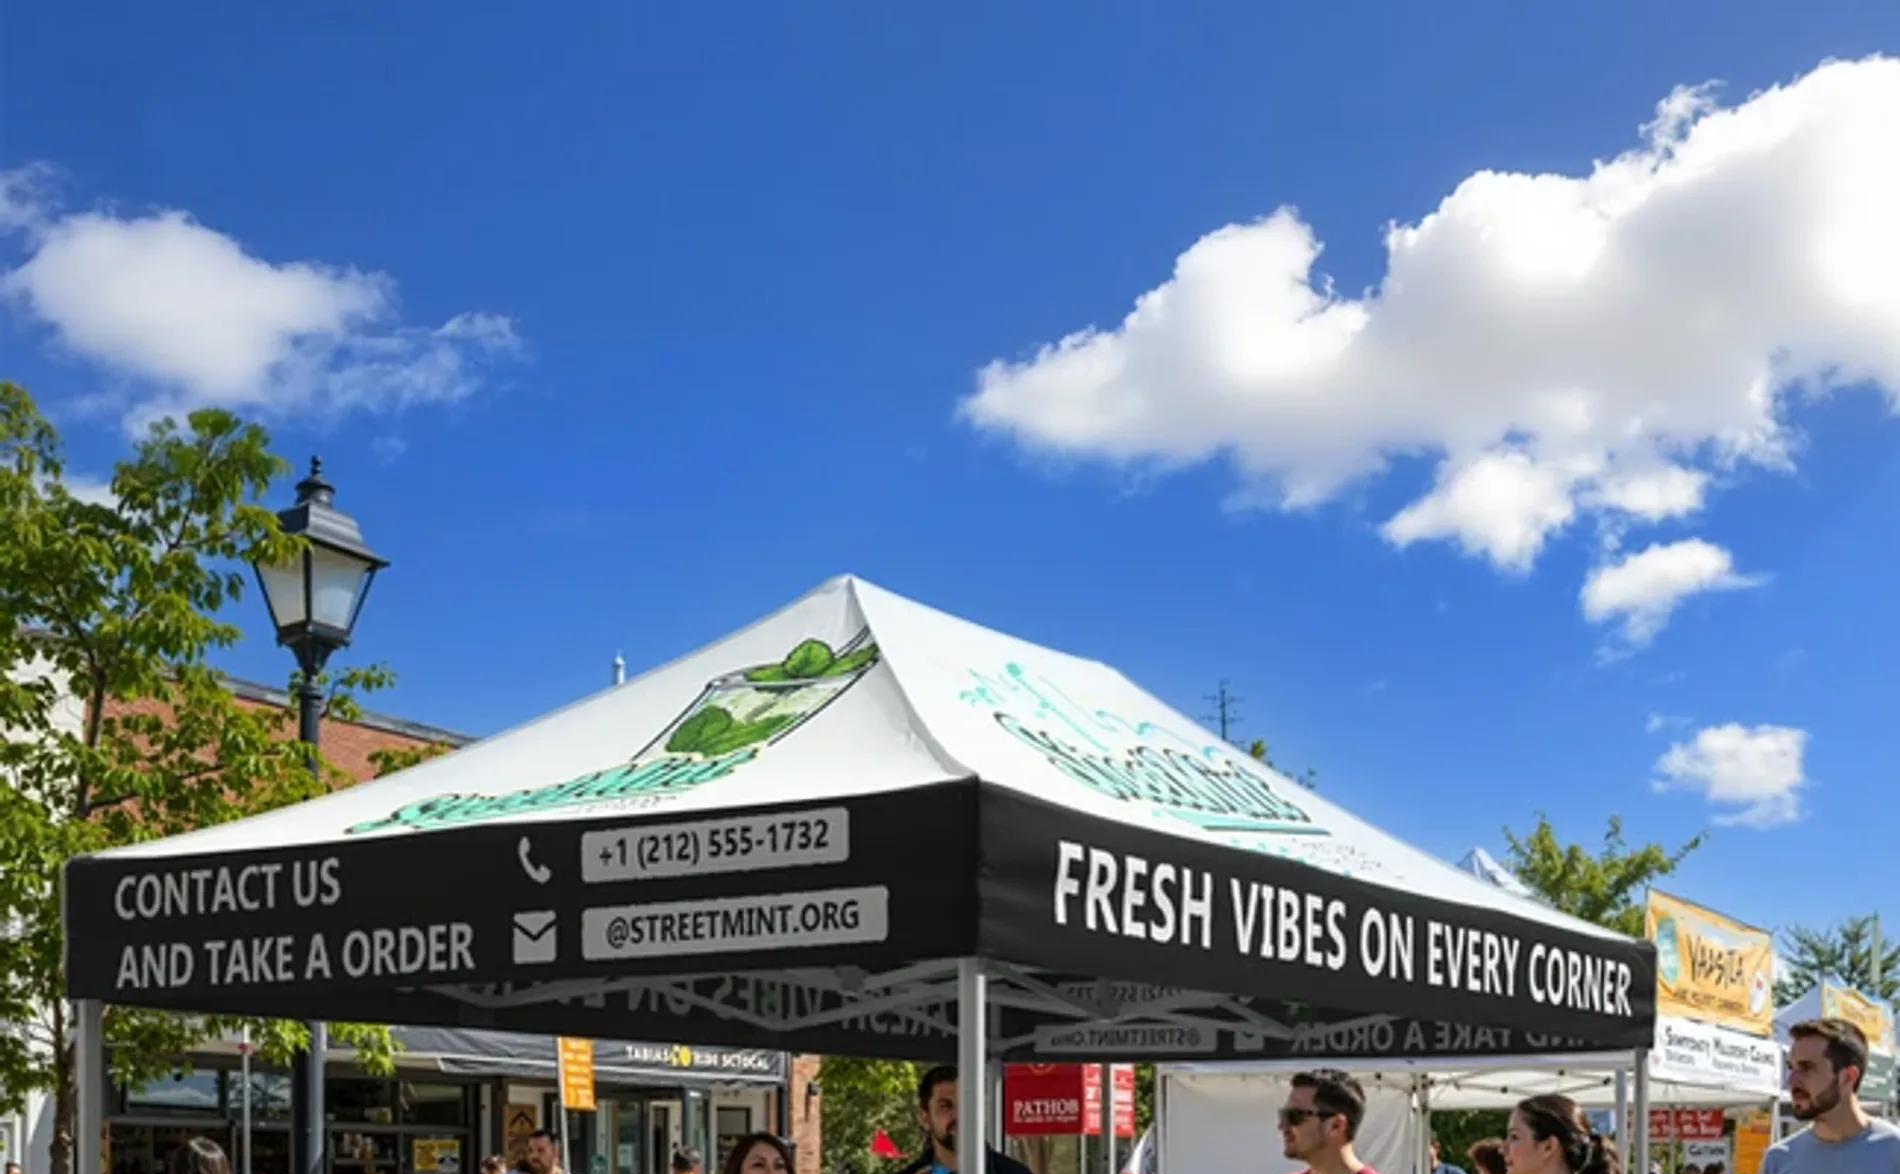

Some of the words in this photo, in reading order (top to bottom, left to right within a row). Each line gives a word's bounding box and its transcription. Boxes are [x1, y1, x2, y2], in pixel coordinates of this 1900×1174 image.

[599, 838, 627, 867] +1
[637, 831, 700, 871] (212)
[708, 818, 829, 858] 555-1732
[114, 863, 282, 920] CONTACT
[293, 857, 341, 906] US
[606, 898, 860, 949] @STREETMINT.ORG
[1053, 839, 1213, 949] FRESH
[1230, 877, 1346, 971] VIBES
[1360, 907, 1414, 982] ON
[1427, 920, 1520, 997] EVERY
[1528, 943, 1632, 1017] CORNER
[116, 940, 194, 989] AND
[204, 936, 295, 985] TAKE
[304, 933, 333, 981] A
[342, 922, 476, 979] ORDER
